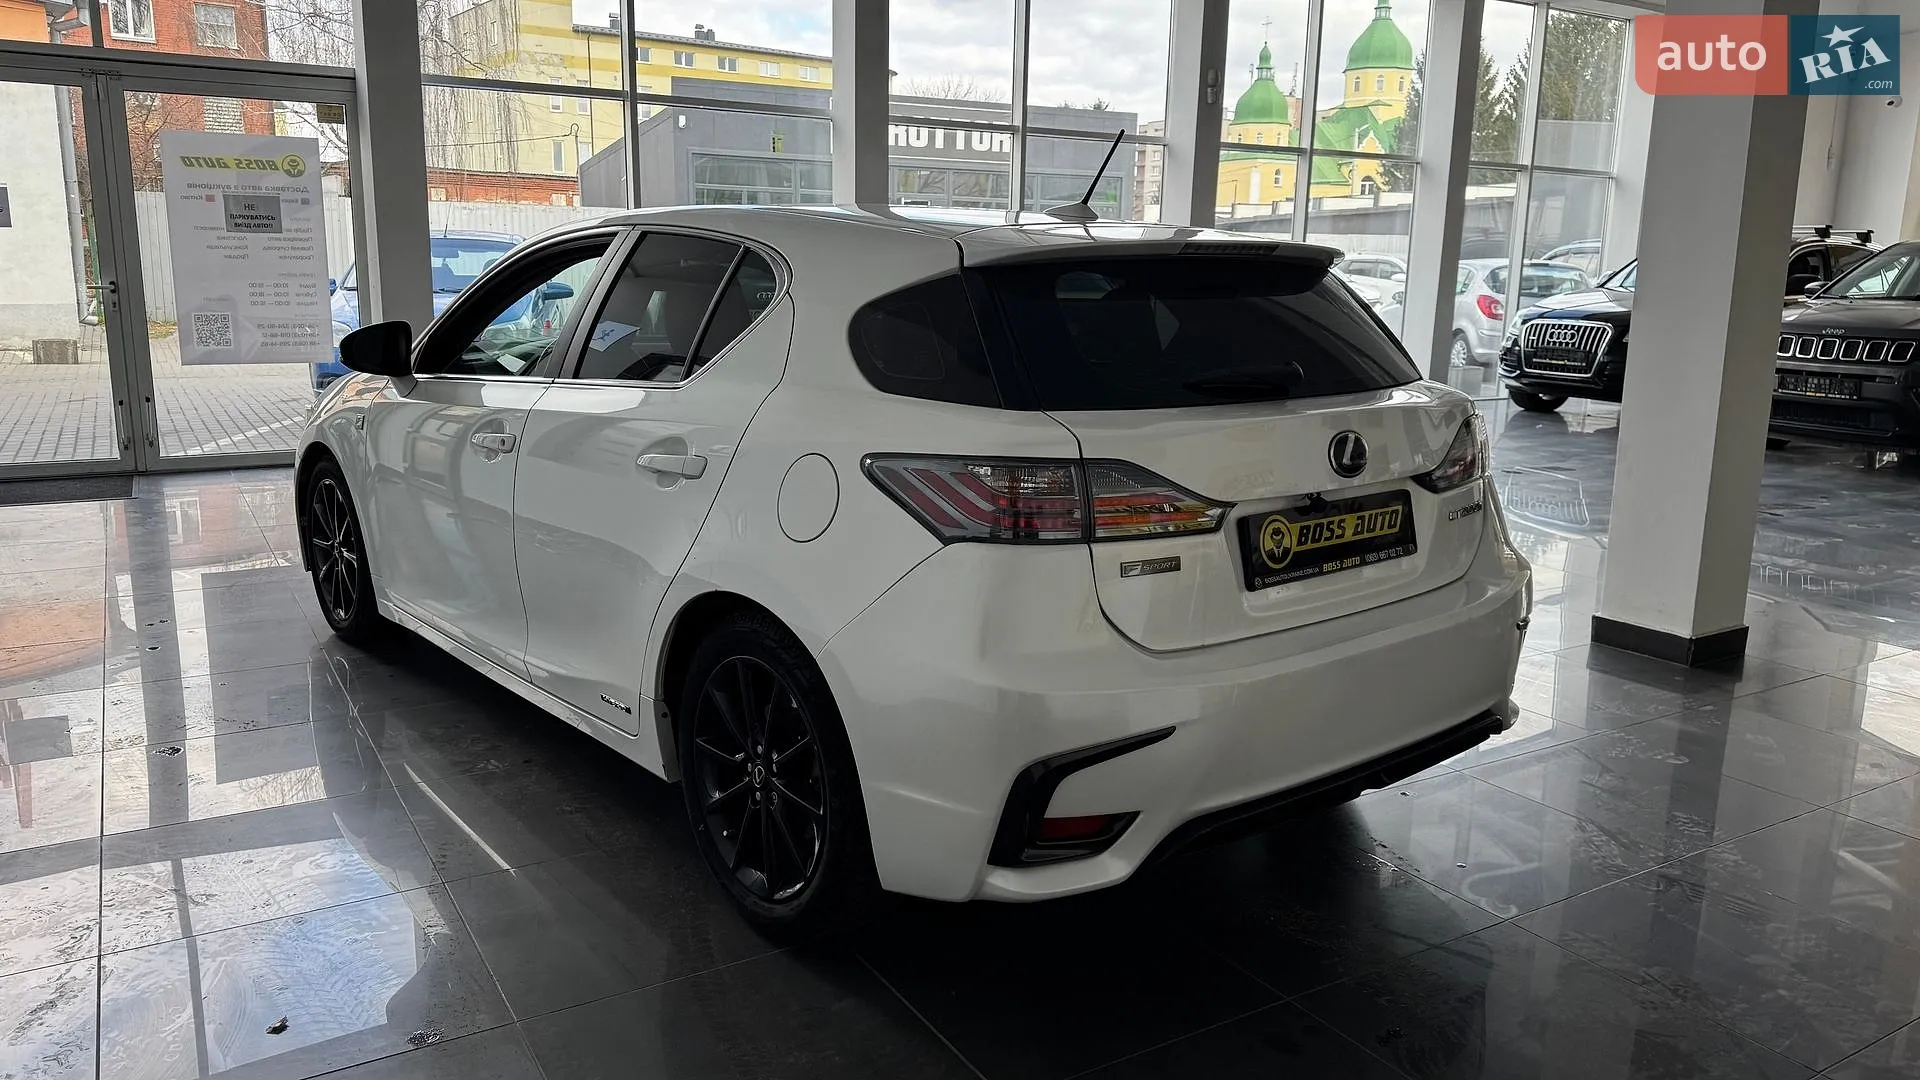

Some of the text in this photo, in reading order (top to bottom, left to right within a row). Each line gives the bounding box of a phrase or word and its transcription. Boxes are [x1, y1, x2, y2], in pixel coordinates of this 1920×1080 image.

[243, 203, 256, 211] НЕ
[1296, 508, 1400, 548] BOSS AUTO
[1143, 562, 1177, 570] SPORT
[1322, 560, 1340, 572] BOSS
[1342, 556, 1360, 568] AUTO
[1396, 546, 1404, 556] 72
